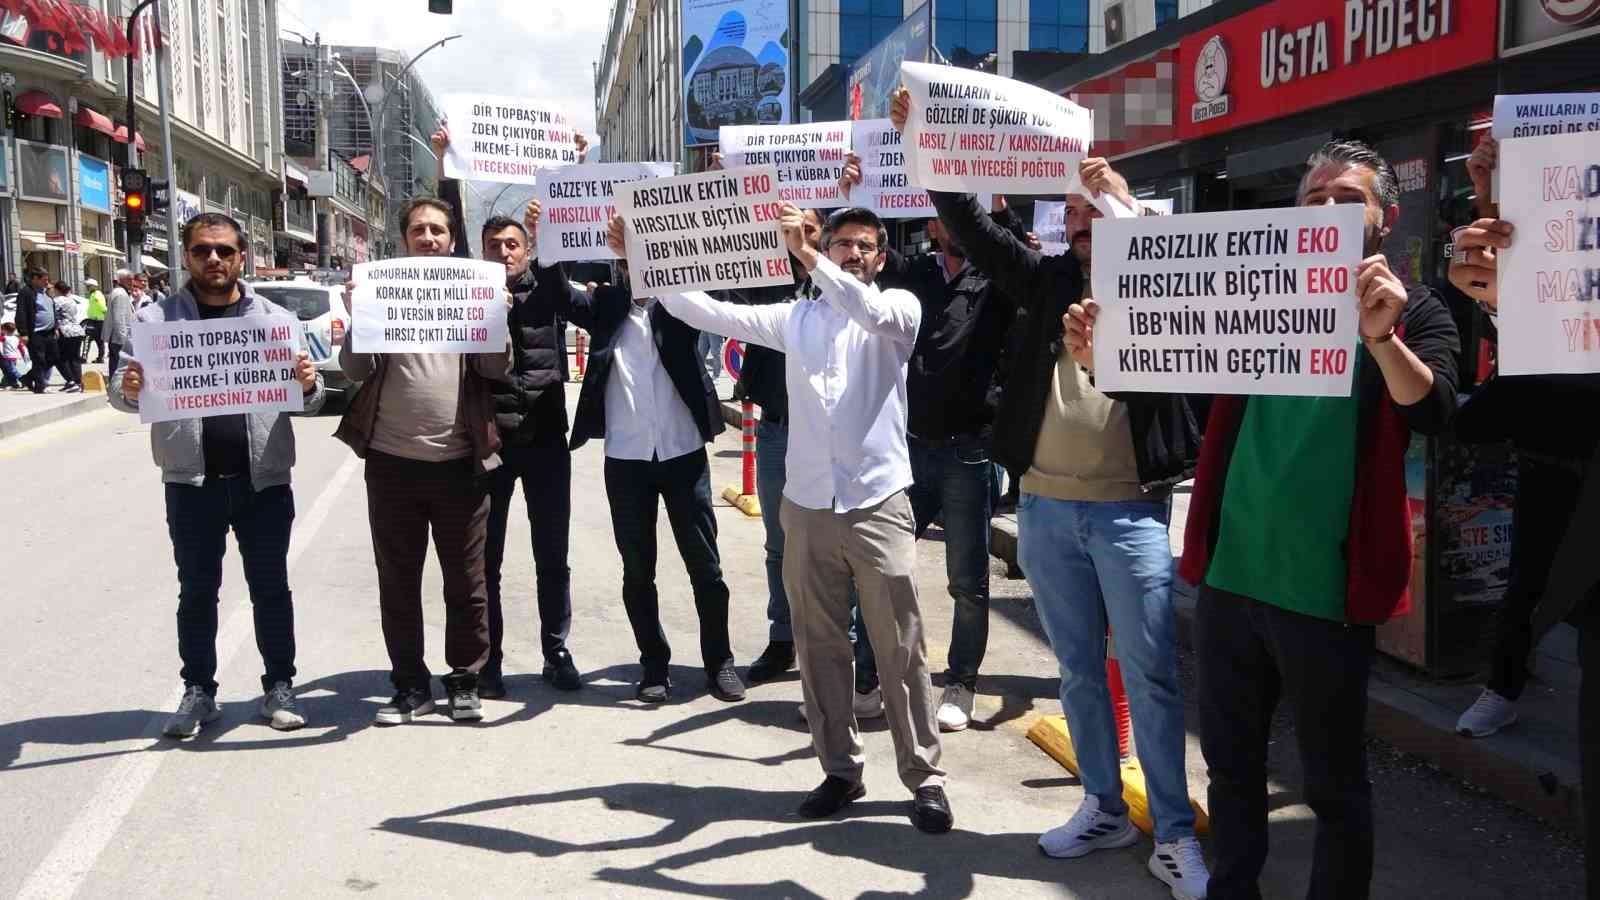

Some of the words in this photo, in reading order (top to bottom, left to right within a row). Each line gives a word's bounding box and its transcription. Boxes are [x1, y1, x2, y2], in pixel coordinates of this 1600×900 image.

[1260, 21, 1329, 89] USTA
[929, 82, 991, 100] VANLILARIN
[495, 106, 551, 124] TOPBAŞ'IN
[926, 103, 968, 125] GÖZLERİ
[972, 108, 986, 125] DE
[1515, 103, 1586, 118] VANLILARIN
[1590, 103, 1600, 114] D
[502, 125, 545, 141] ÇIKIYOR
[769, 132, 822, 147] TOPBAŞ'IN
[825, 131, 844, 143] AHI
[919, 133, 947, 150] ARSIZ
[949, 132, 957, 151] /
[960, 134, 996, 151] HIRSIZ
[999, 132, 1006, 152] /
[1009, 134, 1083, 153] KANSIZLARIN
[523, 145, 559, 160] KÜBRA
[562, 150, 576, 163] DA
[774, 149, 816, 167] ÇIKIYOR
[819, 148, 843, 162] VAHI
[796, 165, 829, 182] KÜBRA
[932, 158, 968, 176] VAN'DA
[971, 155, 1017, 177] YİYECEĞİ
[1021, 156, 1066, 178] POĞTUR
[549, 180, 597, 199] GAZZE'YE
[633, 183, 694, 209] ARSIZLIK
[698, 175, 739, 201] EKTİN
[743, 174, 771, 195] EKO
[815, 186, 839, 199] NAHI
[1543, 163, 1600, 202] KAD
[548, 206, 602, 224] HIRSIZLIK
[632, 211, 701, 235] HIRSIZLIK
[702, 203, 751, 230] BİÇTİN
[752, 203, 781, 222] EKO
[561, 227, 592, 248] BELKİ
[645, 235, 698, 261] İBB'NİN
[701, 230, 779, 255] NAMUSUNU
[1127, 231, 1218, 261] ARSIZLIK
[1226, 223, 1289, 257] EKTİN
[1296, 226, 1339, 254] EKO
[423, 267, 476, 281] KAVURMACI
[641, 261, 711, 289] KİRLETTİN
[716, 256, 762, 284] GEÇTİN
[1118, 271, 1217, 299] HIRSIZLIK
[1224, 263, 1297, 302] BİÇTİN
[1306, 266, 1348, 294] EKO
[376, 286, 413, 301] KORKAK
[416, 287, 441, 304] ÇIKTI
[444, 283, 469, 300] MİLLİ
[471, 286, 494, 300] KEKO
[387, 307, 398, 321] DJ
[401, 304, 434, 321] VERSİN
[437, 303, 464, 321] BİRAZ
[467, 307, 484, 321] ECO
[1128, 305, 1206, 336] İBB'NİN
[1215, 307, 1337, 335] NAMUSUNU
[200, 328, 266, 348] TOPBAŞ'IN
[271, 325, 291, 340] AHI
[384, 327, 416, 342] HIRSIZ
[419, 328, 443, 344] ÇIKTI
[446, 324, 468, 342] ZİLLİ
[471, 327, 488, 342] EKO
[208, 350, 260, 371] ÇIKIYOR
[264, 347, 292, 363] VAHI
[1118, 343, 1218, 374] KİRLETTİN
[1226, 342, 1301, 380] GEÇTİN
[1309, 348, 1348, 375] EKO
[234, 369, 276, 385] KÜBRA
[281, 368, 297, 382] DA
[257, 388, 288, 404] NAHI
